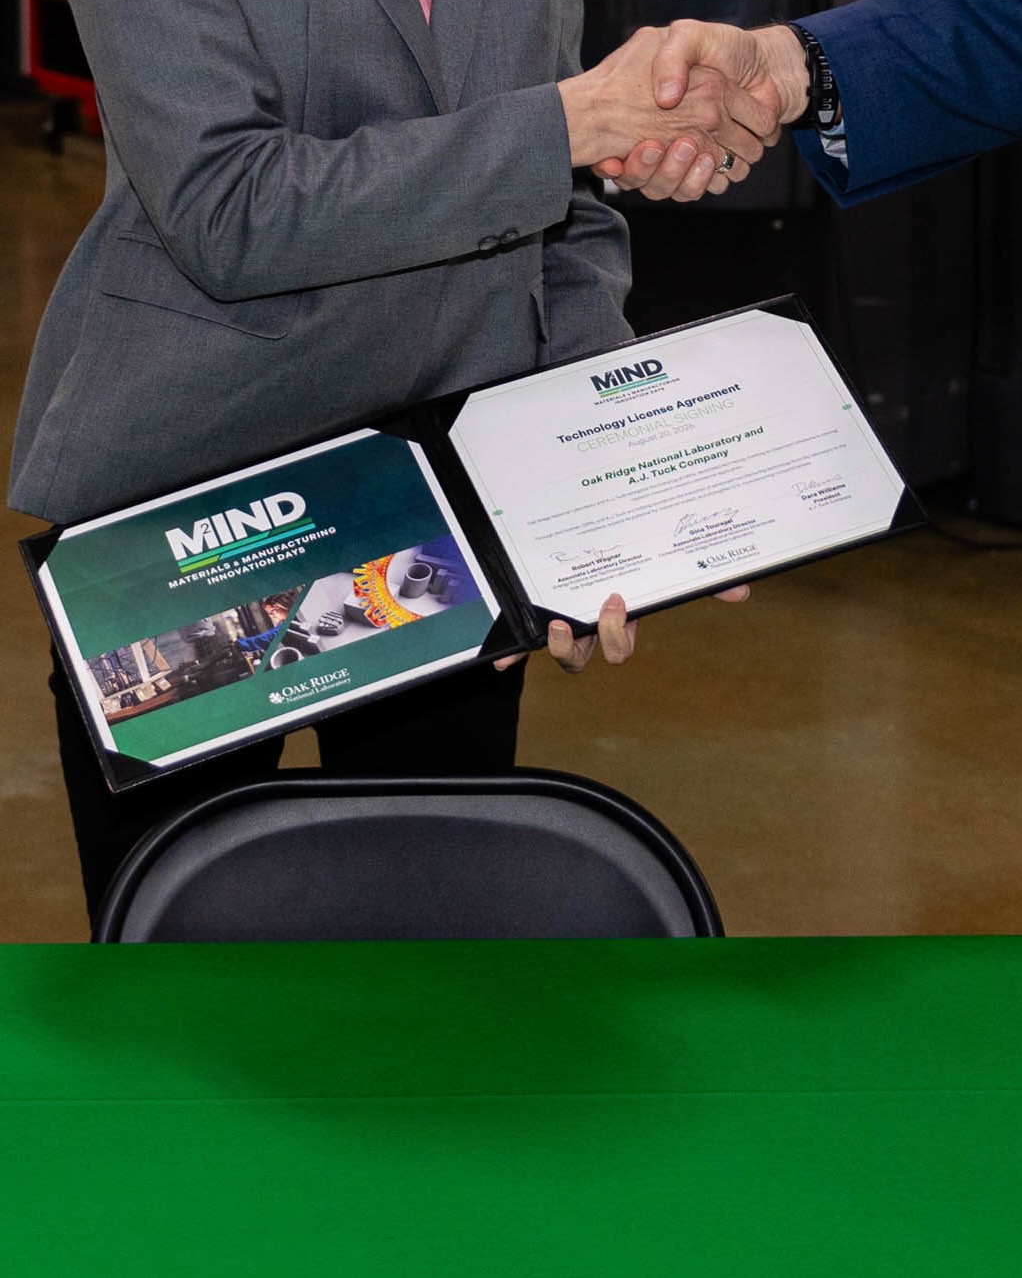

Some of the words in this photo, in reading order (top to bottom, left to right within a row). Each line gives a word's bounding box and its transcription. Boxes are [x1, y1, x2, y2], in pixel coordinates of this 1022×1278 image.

[557, 419, 626, 444] Technology
[627, 405, 674, 424] License
[676, 383, 741, 410] Agreement
[577, 419, 672, 453] CEREMONIAL
[673, 398, 735, 424] SIGNING
[628, 433, 658, 448] August
[581, 475, 604, 488] Oak
[605, 466, 636, 482] Ridge
[638, 451, 683, 470] National
[684, 433, 743, 458] Laboratory
[744, 426, 764, 439] and
[628, 474, 649, 485] A.J.
[651, 465, 678, 478] Tuck
[679, 449, 730, 469] Company
[168, 561, 231, 589] MATERIALS
[241, 526, 337, 564] MANUFACTURING
[207, 556, 275, 585] INNOVATION
[277, 546, 306, 561] DAYS
[571, 560, 595, 571] Robert
[595, 553, 621, 566] Wagner
[587, 562, 618, 575] Laboratory
[706, 553, 727, 564] OAK
[727, 544, 758, 559] RIDGE
[282, 682, 310, 697] OAK
[310, 668, 350, 688] RIDGE
[286, 689, 315, 703] National
[315, 677, 352, 694] Laboratory
